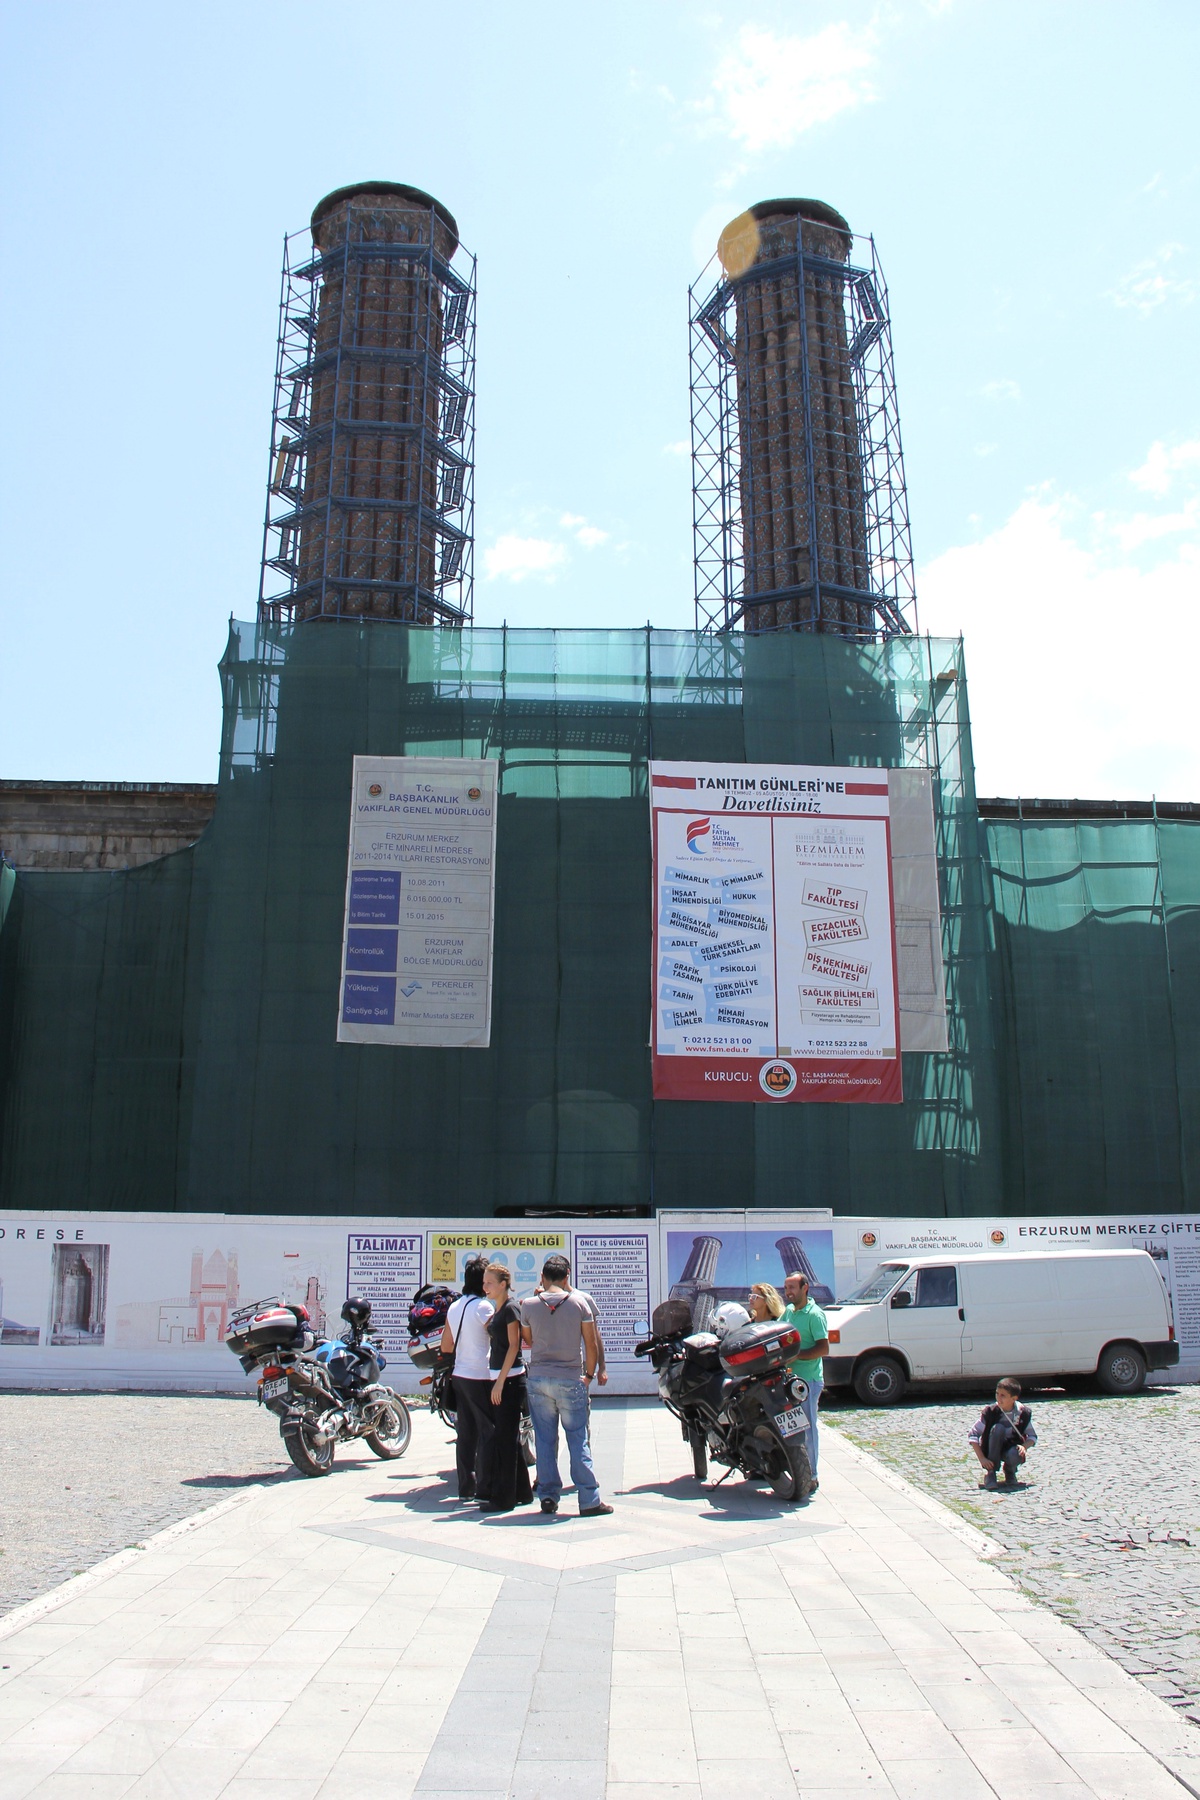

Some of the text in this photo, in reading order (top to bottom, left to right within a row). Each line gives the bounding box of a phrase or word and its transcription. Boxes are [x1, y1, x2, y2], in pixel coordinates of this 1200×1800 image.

[416, 784, 434, 792] T.C.
[697, 777, 756, 790] TANITIM
[389, 793, 459, 804] BAŞBAKANLIK
[358, 805, 491, 817] VAKIFLAR GENEL MÜDÜRLÜĞÜ
[386, 832, 460, 843] ERZURUM MERKEZ
[371, 842, 473, 855] ÇİFTE MİNARELİ MEDRESE
[354, 853, 490, 866] 2011-2014 YILLARI RESTORASYONU
[407, 879, 445, 887] 10.08.2011
[675, 871, 710, 885] MİMARLIK
[721, 871, 764, 887] İÇ MİMARLIK
[672, 887, 697, 898] İNŞAAT
[827, 887, 842, 897] TIP
[672, 896, 722, 905] MÜHENDİSLİĞİ
[807, 892, 859, 911] FAKÜLTESİ
[406, 912, 445, 921] 15.01.2015
[671, 911, 712, 930] BİLGİSAYAR
[719, 909, 766, 924] BİYOMEDİKAL
[669, 919, 719, 939] MÜHENDİSLİĞİ
[717, 916, 768, 932] MÜHENDİSLİĞİ
[811, 918, 859, 933] ECZACILIK
[811, 925, 862, 942] FAKÜLTESİ
[424, 938, 464, 947] ERZURUM
[700, 939, 746, 955] GELENEKSEL
[349, 946, 385, 955] Kontrollük
[425, 948, 463, 956] VAKIFLAR
[702, 943, 761, 961] TÜRK SANATLARI
[404, 956, 484, 967] BÖLGE MÜDÜRLÜĞÜ
[807, 952, 868, 975] DİŞ HEKİMLİĞİ
[673, 962, 700, 976] GRAFİK
[720, 963, 757, 973] PSİKOLOJİ
[811, 963, 860, 982] FAKÜLTESİ
[672, 969, 703, 984] TASARIM
[347, 983, 379, 993] Yüklenici
[431, 981, 474, 989] PEKERLER
[714, 979, 759, 992] TÜRK DİLİ VE
[672, 989, 694, 1001] TARİH
[715, 987, 753, 999] EDEBİYATI
[802, 988, 875, 999] SAĞLIK BİLİMLERİ
[816, 997, 862, 1007] FAKÜLTESİ
[346, 1006, 389, 1017] Şantiye Şefi
[401, 1011, 422, 1019] Mimar
[423, 1012, 449, 1020] Mustafa
[672, 1008, 698, 1019] İSLAMİ
[718, 1008, 745, 1018] MİMARİ
[674, 1016, 703, 1027] İLİMLER
[717, 1016, 769, 1028] RESTORASYON
[691, 1036, 711, 1044] 0212
[685, 1045, 750, 1053] www.fsm.edu.tr
[793, 1047, 882, 1056] www.bezmialem.edu.tr
[704, 1071, 752, 1082] KURUCU:
[847, 1078, 882, 1086] MÜDÜRLÜĞÜ
[1018, 1222, 1200, 1237] ERZURUM MERKEZ ÇİFTE
[438, 1235, 560, 1248] ÖNCE İŞ GÜVENLİĞİ
[580, 1239, 598, 1247] ÖNCE
[600, 1239, 607, 1247] İŞ
[942, 1241, 983, 1249] MÜDÜRLÜĞÜ
[270, 1388, 278, 1396] 71
[776, 1408, 803, 1424] 07 BYK
[787, 1420, 798, 1429] 43
